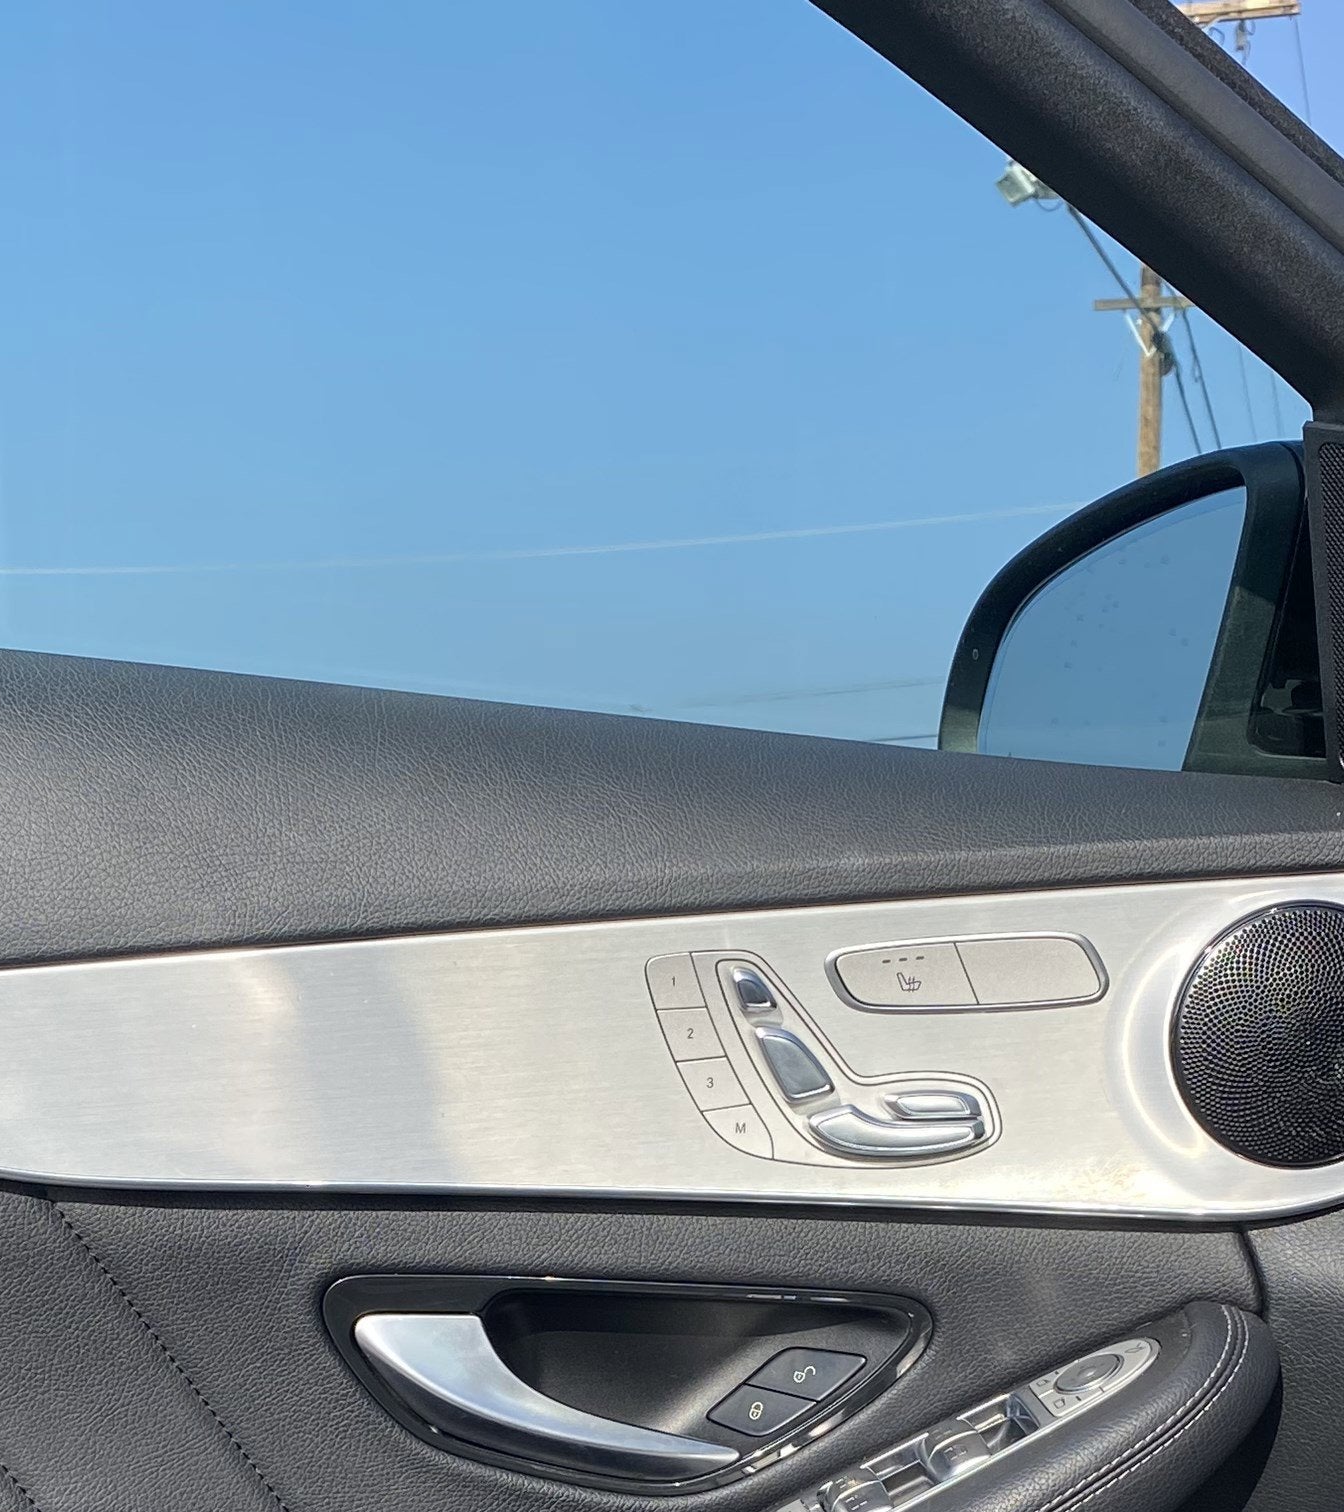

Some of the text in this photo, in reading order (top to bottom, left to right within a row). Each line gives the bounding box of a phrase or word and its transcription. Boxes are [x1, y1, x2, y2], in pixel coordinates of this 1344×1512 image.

[671, 976, 676, 987] 1
[687, 1027, 694, 1040] 2
[706, 1076, 715, 1089] 3
[735, 1122, 747, 1134] M
